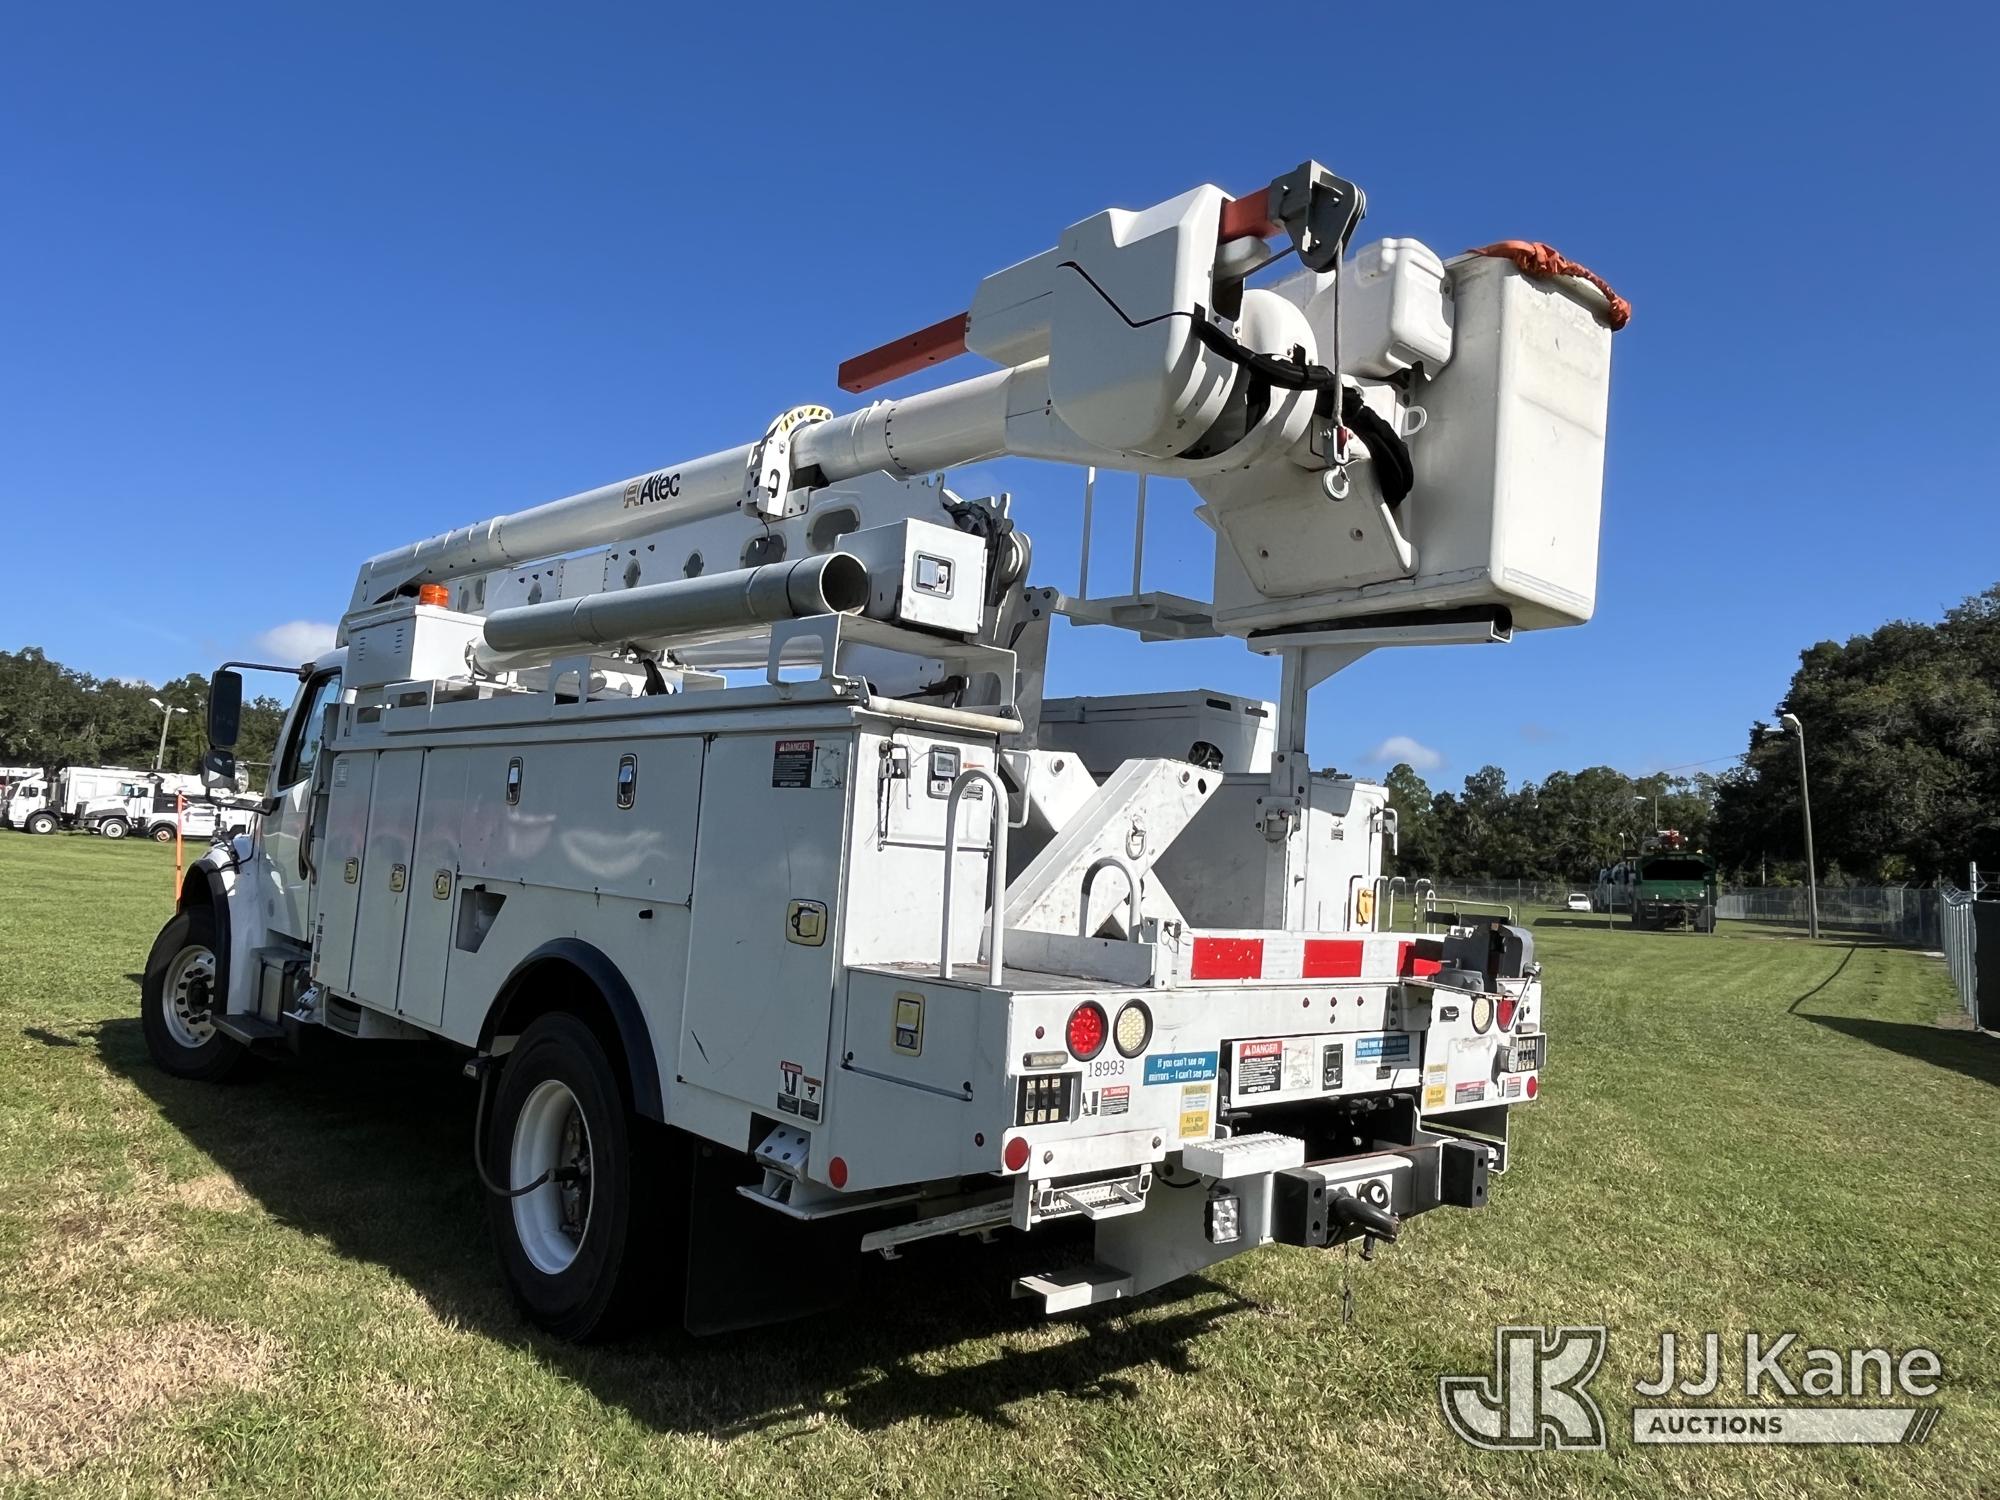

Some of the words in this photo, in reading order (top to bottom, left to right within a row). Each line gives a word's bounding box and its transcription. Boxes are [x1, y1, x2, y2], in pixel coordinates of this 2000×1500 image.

[640, 473, 681, 505] Altec
[785, 742, 810, 751] DANGER
[1252, 1044, 1278, 1053] DANGER
[1088, 1060, 1125, 1077] 18993
